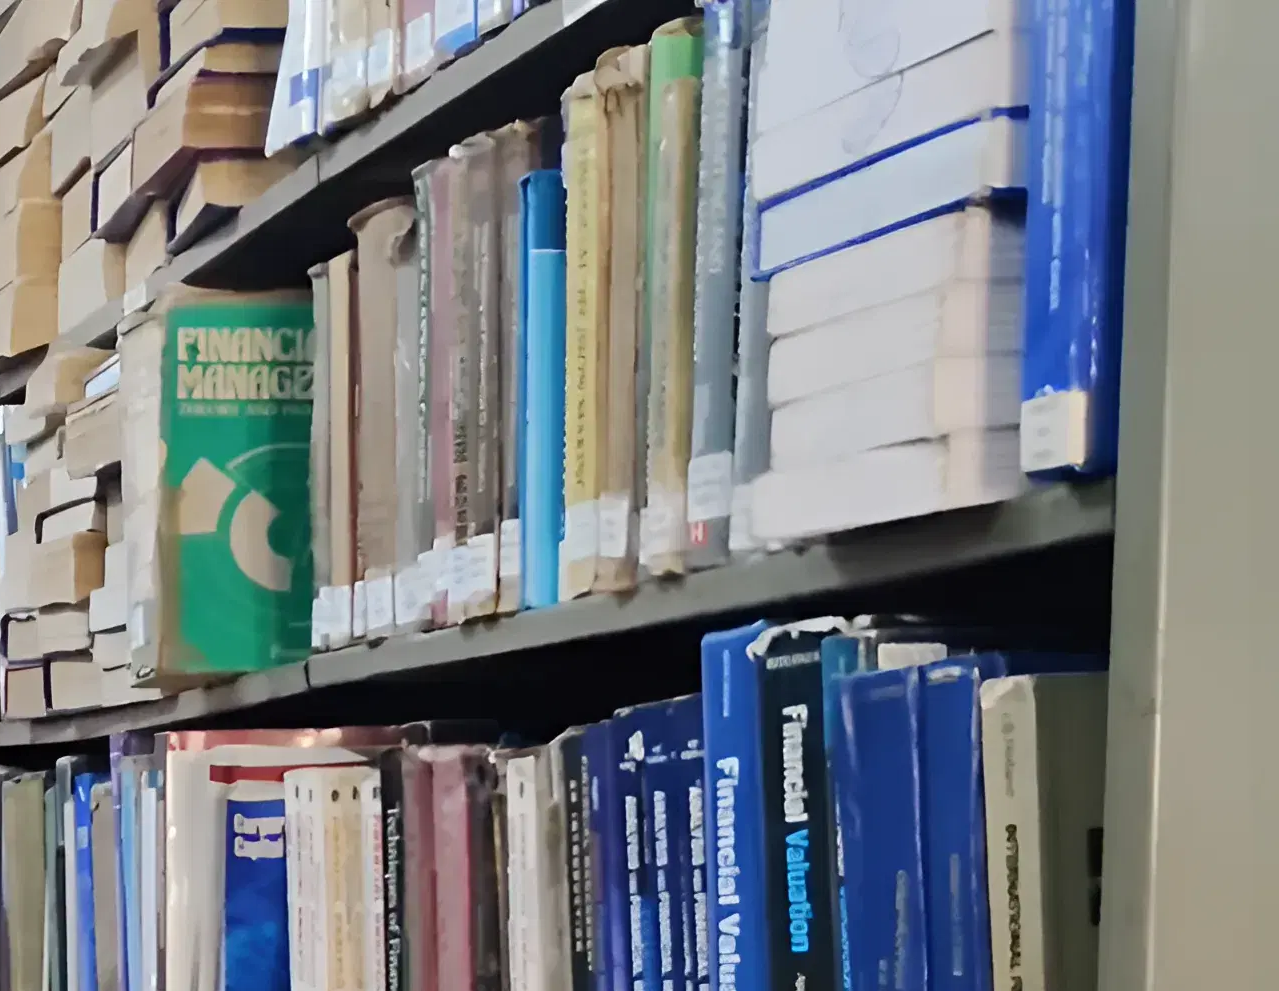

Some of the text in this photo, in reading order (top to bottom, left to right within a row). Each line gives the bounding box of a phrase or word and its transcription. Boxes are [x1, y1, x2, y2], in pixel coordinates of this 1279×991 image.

[782, 704, 809, 823] Financial
[385, 801, 400, 908] Techniques
[717, 757, 740, 905] Financial
[785, 829, 813, 952] Valuation
[389, 912, 400, 935] of
